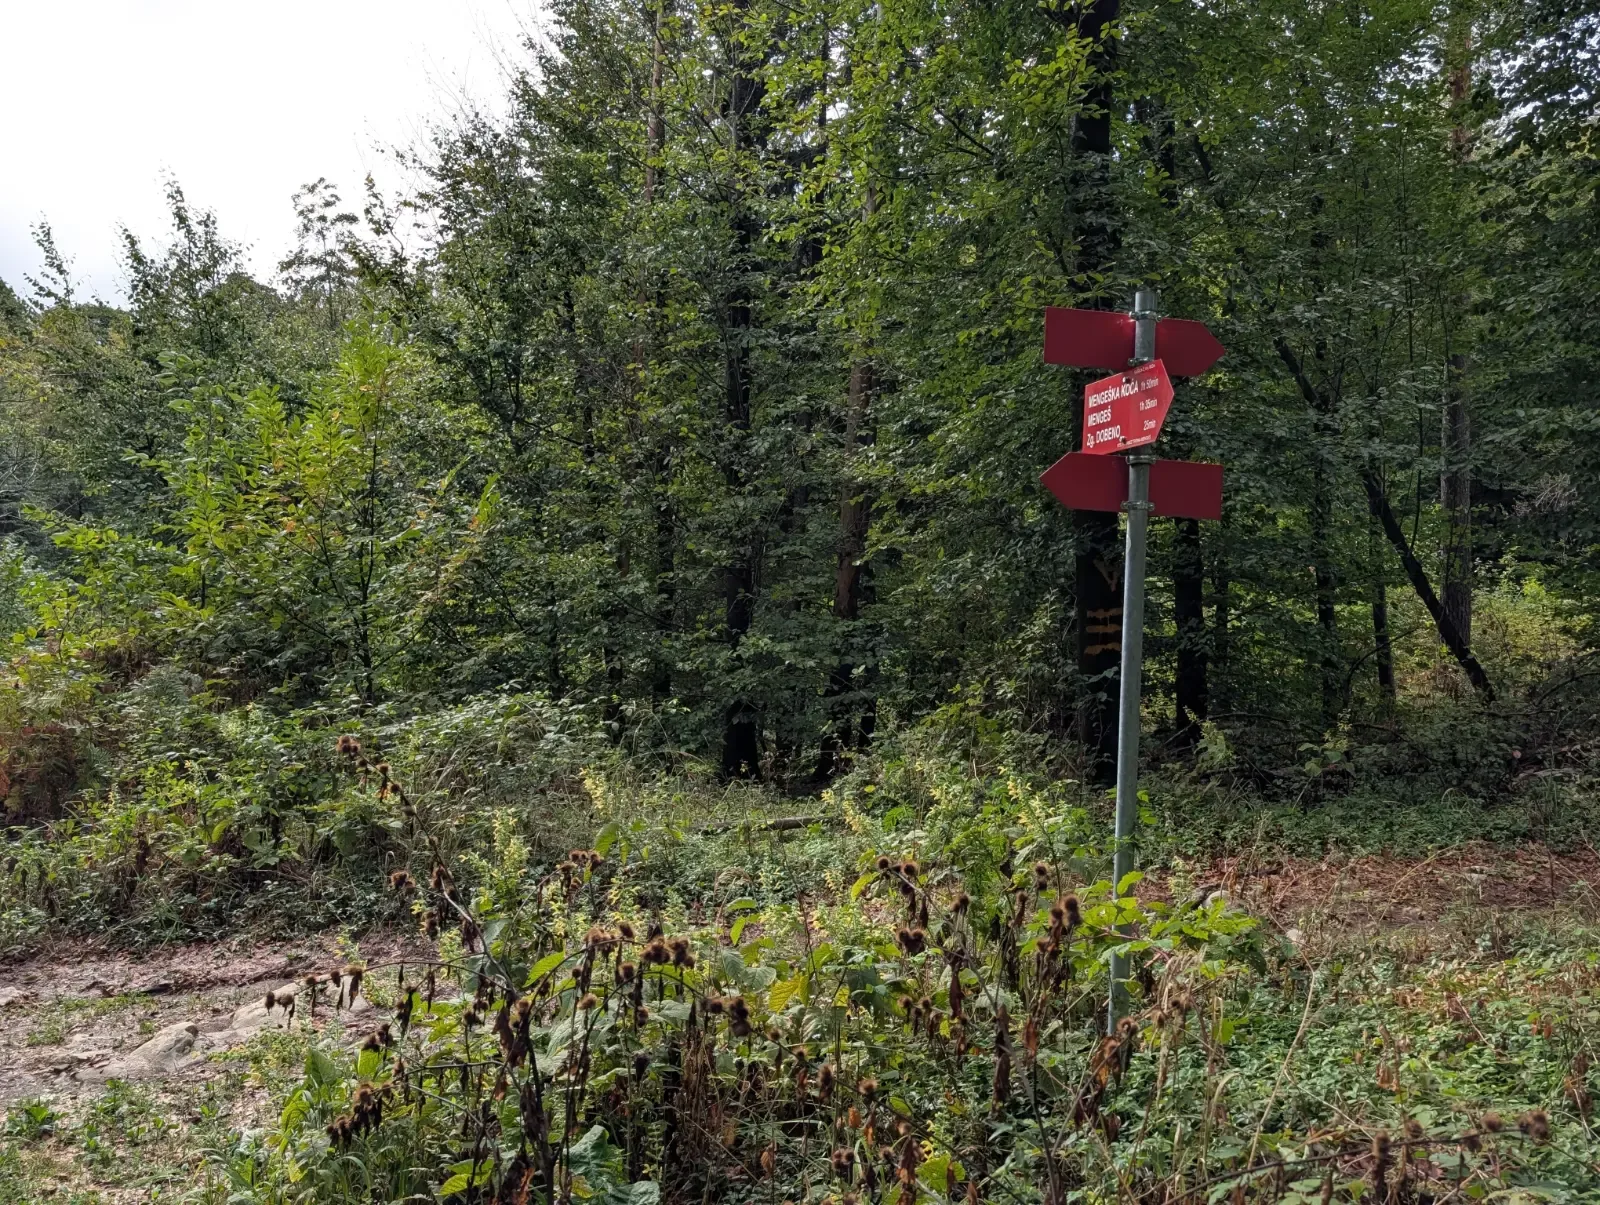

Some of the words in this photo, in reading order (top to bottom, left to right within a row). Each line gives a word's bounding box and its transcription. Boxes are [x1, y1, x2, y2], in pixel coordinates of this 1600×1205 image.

[1088, 386, 1120, 408] MENGEŠKA
[1139, 401, 1145, 411] 1h
[1087, 405, 1112, 427] MENGEŠ
[1086, 433, 1095, 448] Zg.
[1096, 425, 1121, 443] DOBENO
